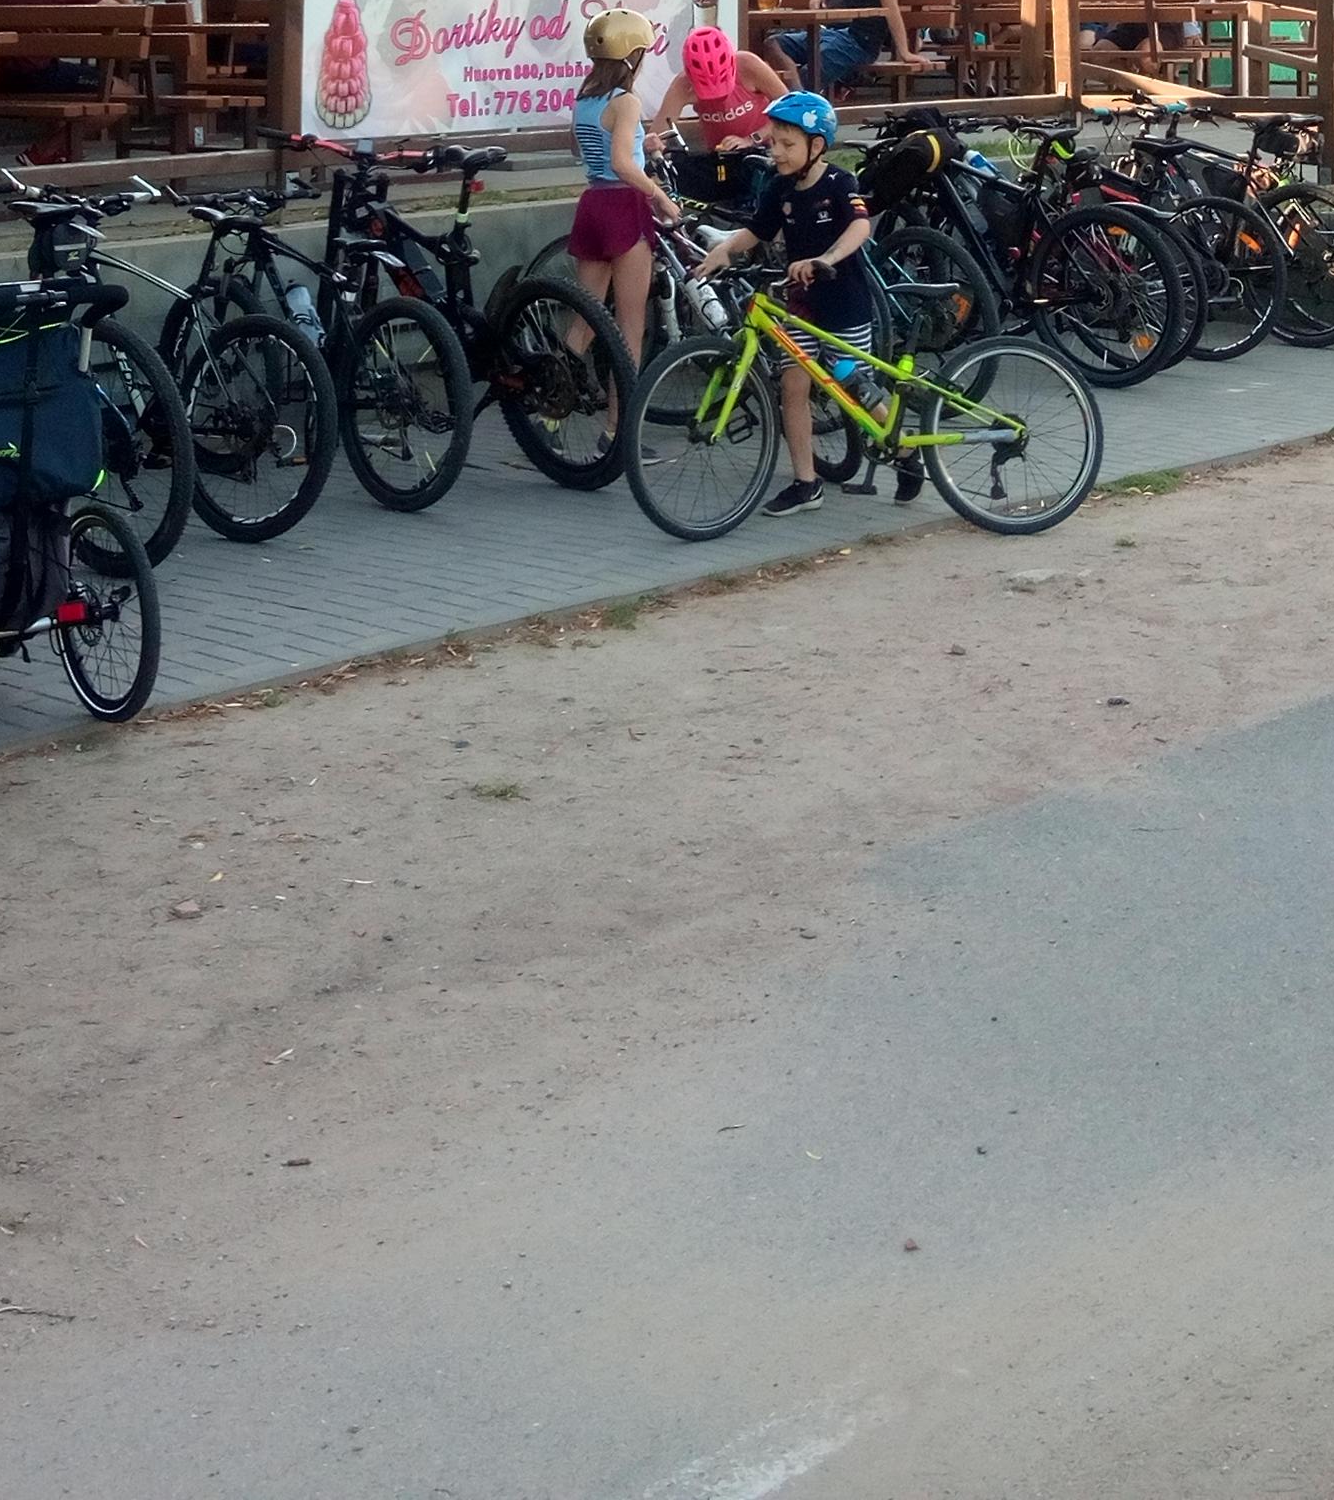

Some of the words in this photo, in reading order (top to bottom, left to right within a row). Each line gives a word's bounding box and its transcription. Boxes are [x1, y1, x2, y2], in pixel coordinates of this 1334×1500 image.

[529, 0, 571, 40] od
[463, 66, 513, 81] Husova
[545, 61, 592, 78] Dubňa
[494, 90, 532, 115] 776
[536, 88, 575, 112] 204
[702, 100, 755, 123] adidas
